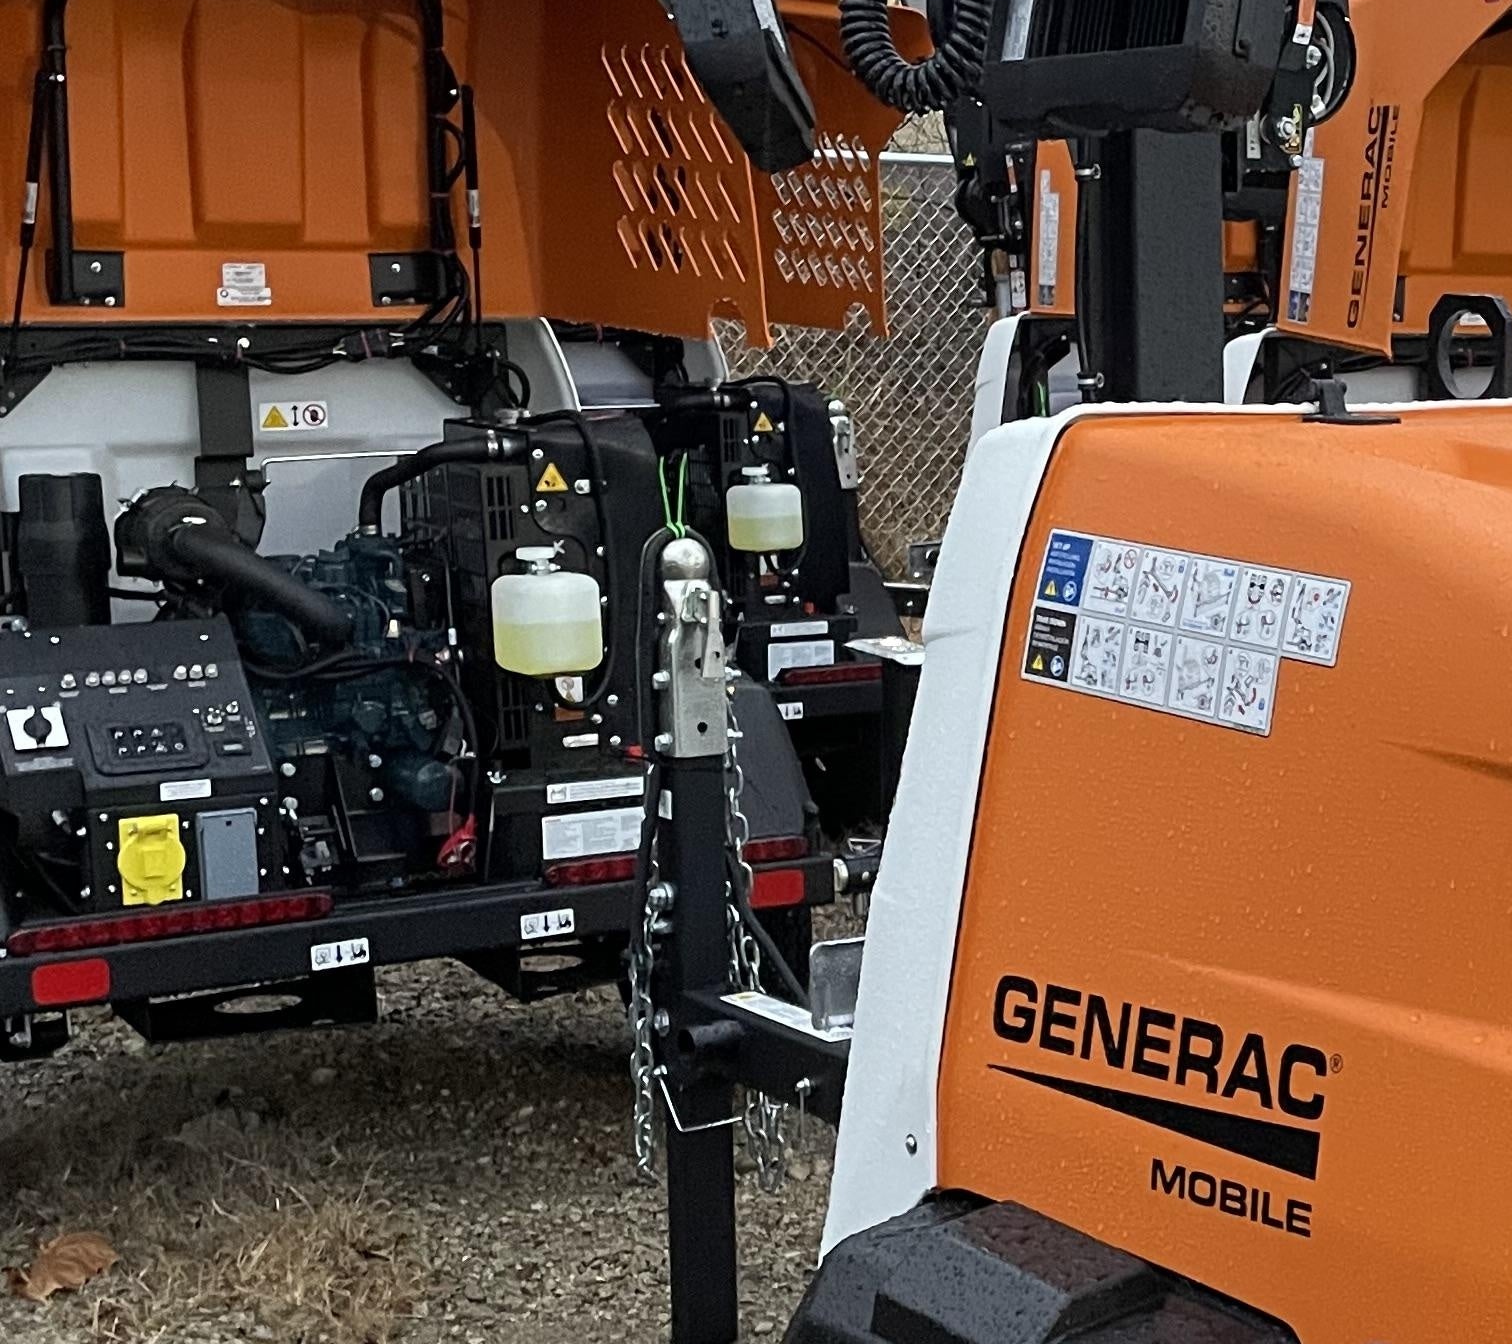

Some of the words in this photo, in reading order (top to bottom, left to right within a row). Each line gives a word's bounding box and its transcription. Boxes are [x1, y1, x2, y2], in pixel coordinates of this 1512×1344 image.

[1346, 105, 1381, 329] GENERAC
[1381, 104, 1400, 209] MOBILE
[993, 974, 1327, 1121] GENERAC
[1150, 1158, 1313, 1239] MOBILE
